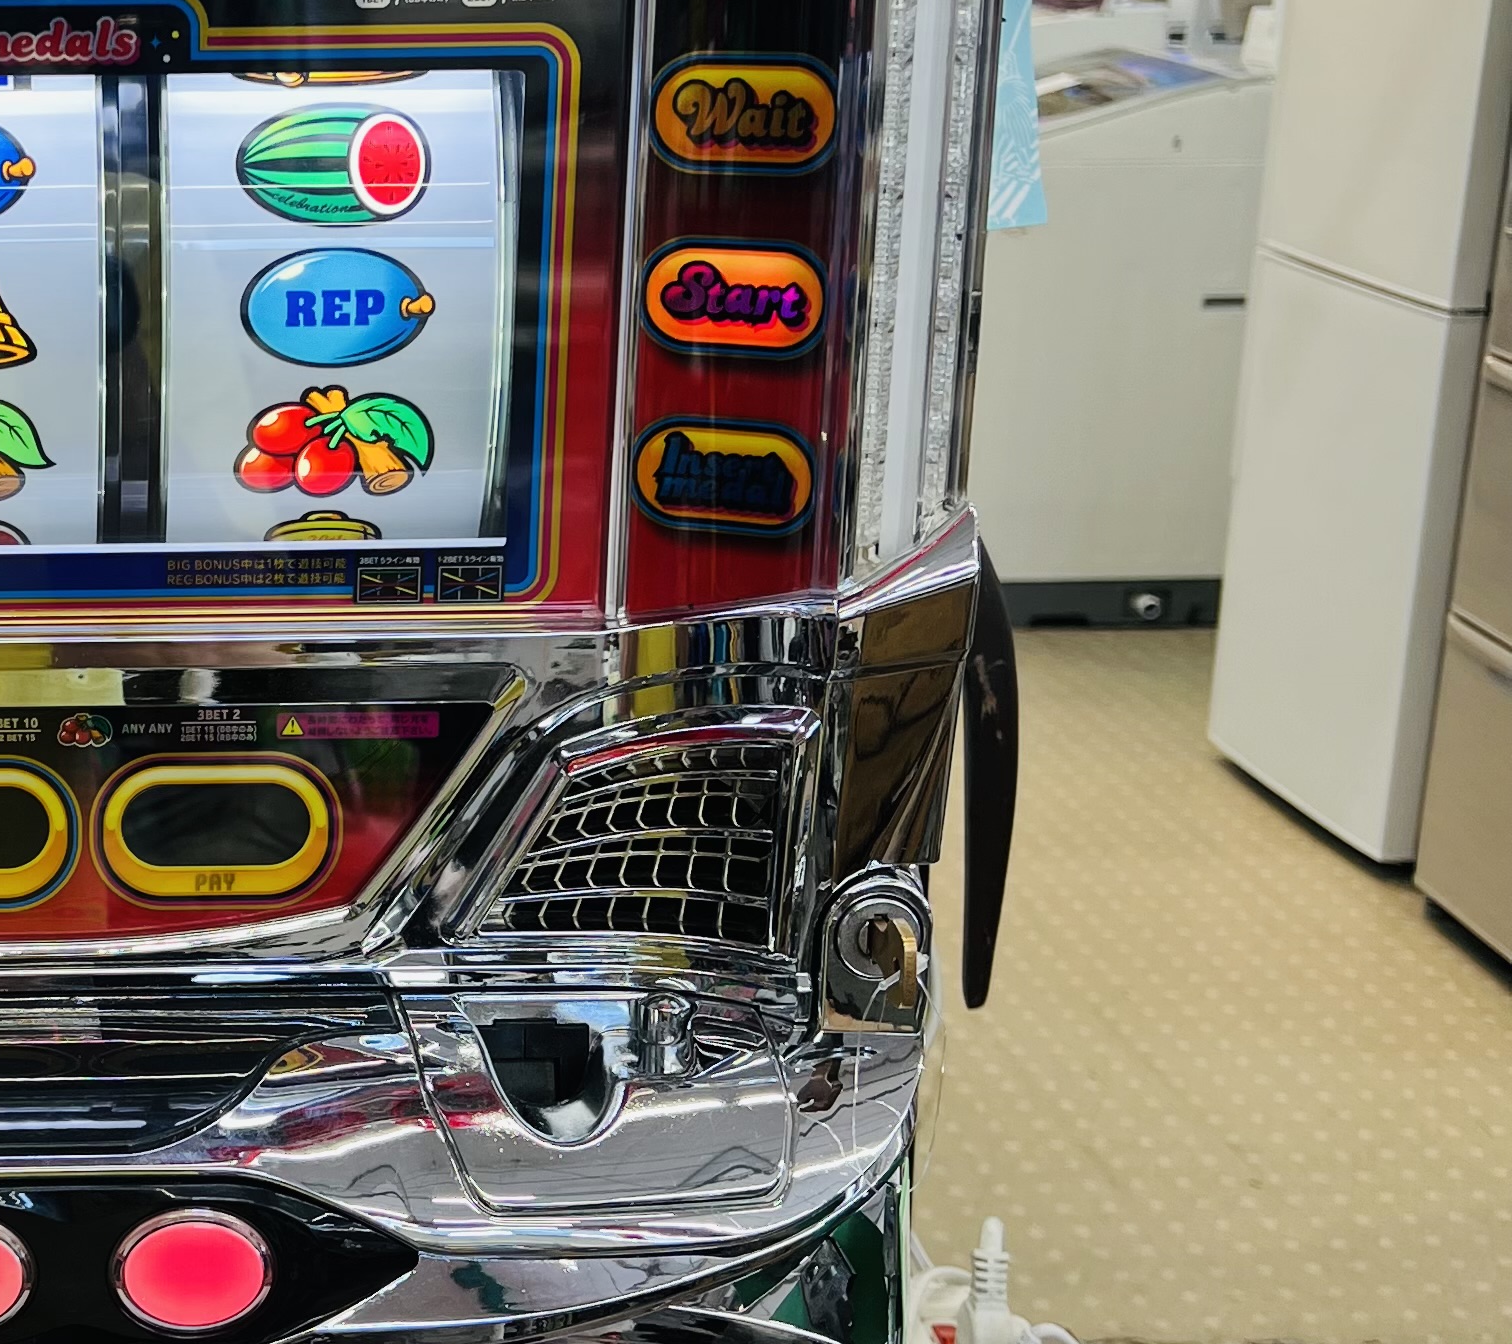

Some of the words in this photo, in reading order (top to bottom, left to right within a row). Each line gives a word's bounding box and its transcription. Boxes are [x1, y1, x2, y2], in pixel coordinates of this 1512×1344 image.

[676, 78, 812, 140] Wait
[664, 262, 800, 323] Start
[285, 289, 386, 329] REP
[166, 559, 191, 571] BIG
[23, 717, 38, 729] 10
[121, 723, 146, 734] ANY
[149, 723, 173, 734] ANY
[197, 709, 229, 721] 3BET
[233, 709, 241, 720] 2
[195, 873, 235, 892] PAY
